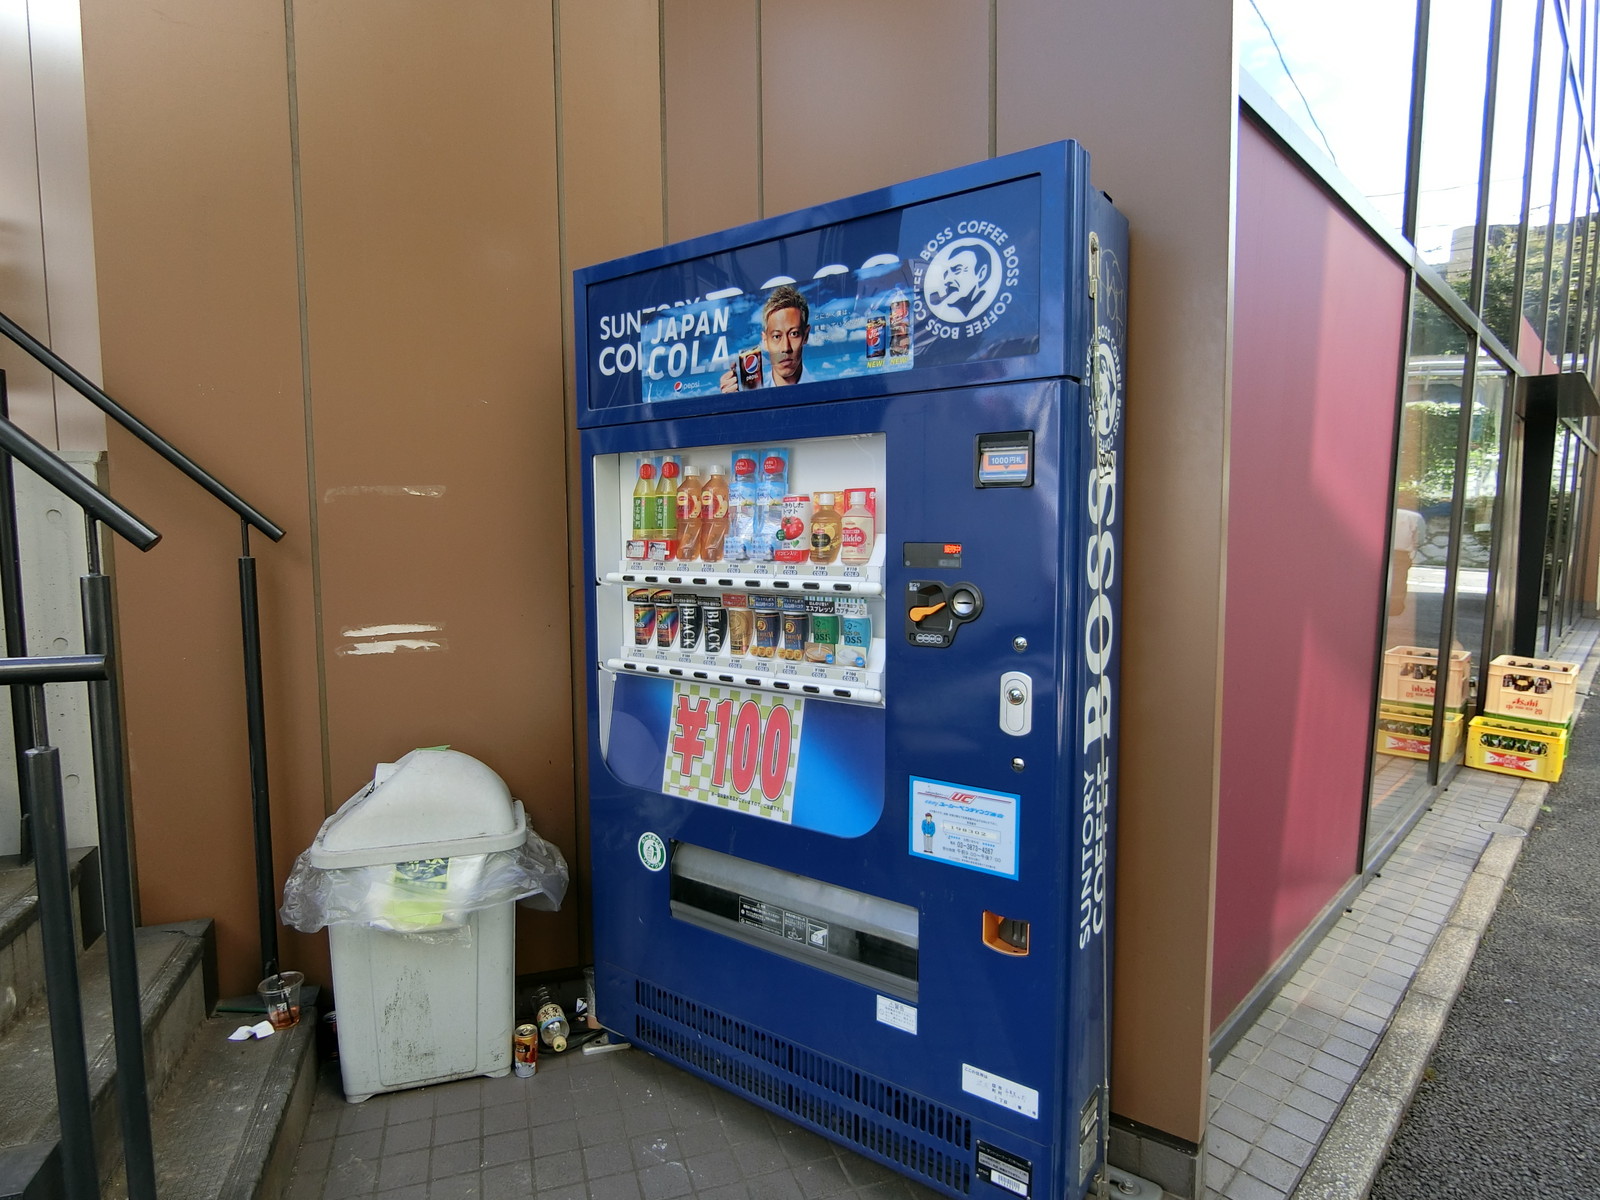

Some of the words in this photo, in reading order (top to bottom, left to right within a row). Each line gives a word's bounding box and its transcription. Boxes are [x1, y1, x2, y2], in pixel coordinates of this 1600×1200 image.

[920, 227, 953, 261] BOSS
[957, 220, 1008, 246] COFFEE
[1003, 245, 1019, 287] BOSS
[651, 306, 729, 344] JAPAN
[925, 319, 960, 340] BOSS
[966, 292, 1017, 338] COFFEE
[649, 335, 730, 380] COLA
[866, 359, 885, 369] NEW!
[683, 381, 700, 391] pepsi
[991, 456, 1024, 465] 1000円札
[683, 606, 696, 650] BLACK
[707, 610, 721, 652] BLACK
[1084, 468, 1116, 754] BOSS
[1512, 697, 1539, 708] Asahi
[672, 694, 793, 803] ¥100
[951, 792, 975, 804] UC
[1080, 770, 1095, 950] SUNTORY
[1092, 755, 1109, 935] COFFEE
